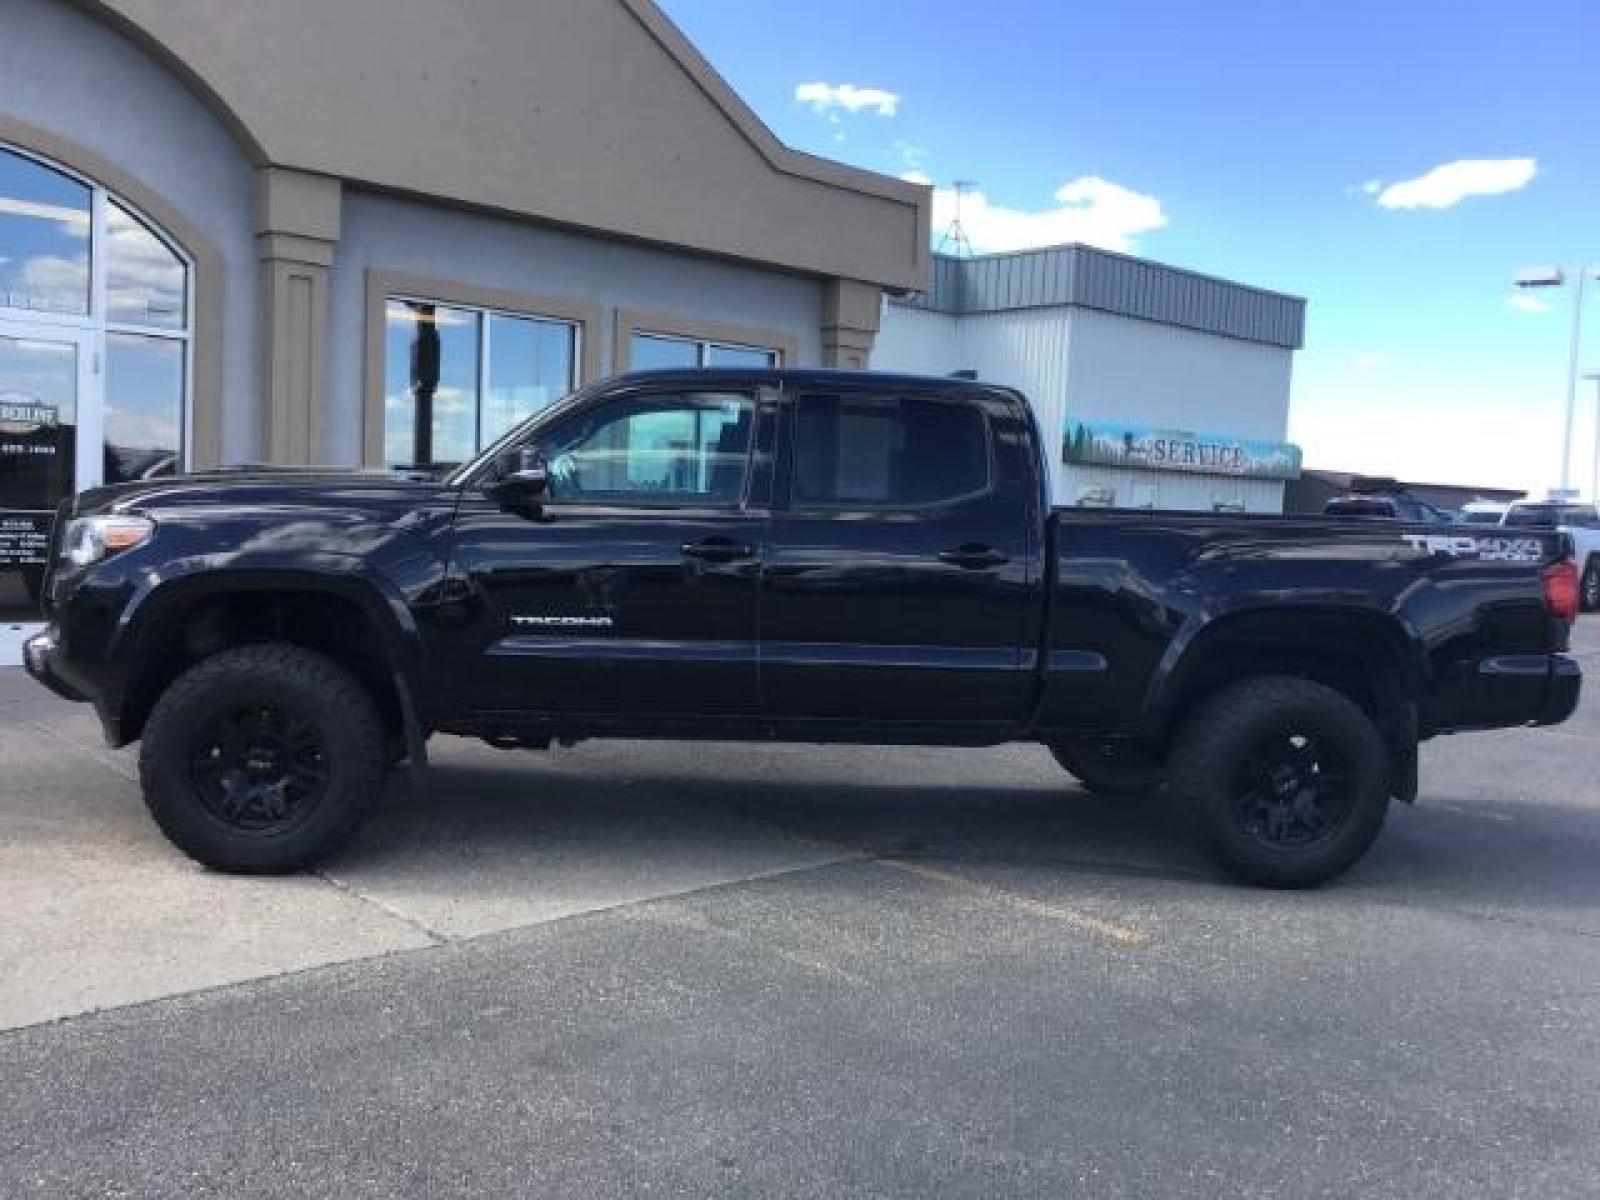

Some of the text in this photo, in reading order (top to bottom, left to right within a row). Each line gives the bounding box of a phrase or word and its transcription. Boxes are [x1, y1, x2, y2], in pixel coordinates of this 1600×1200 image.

[1153, 438, 1243, 468] SERVICE
[1400, 534, 1476, 556] TRD
[511, 616, 613, 626] TACOMA
